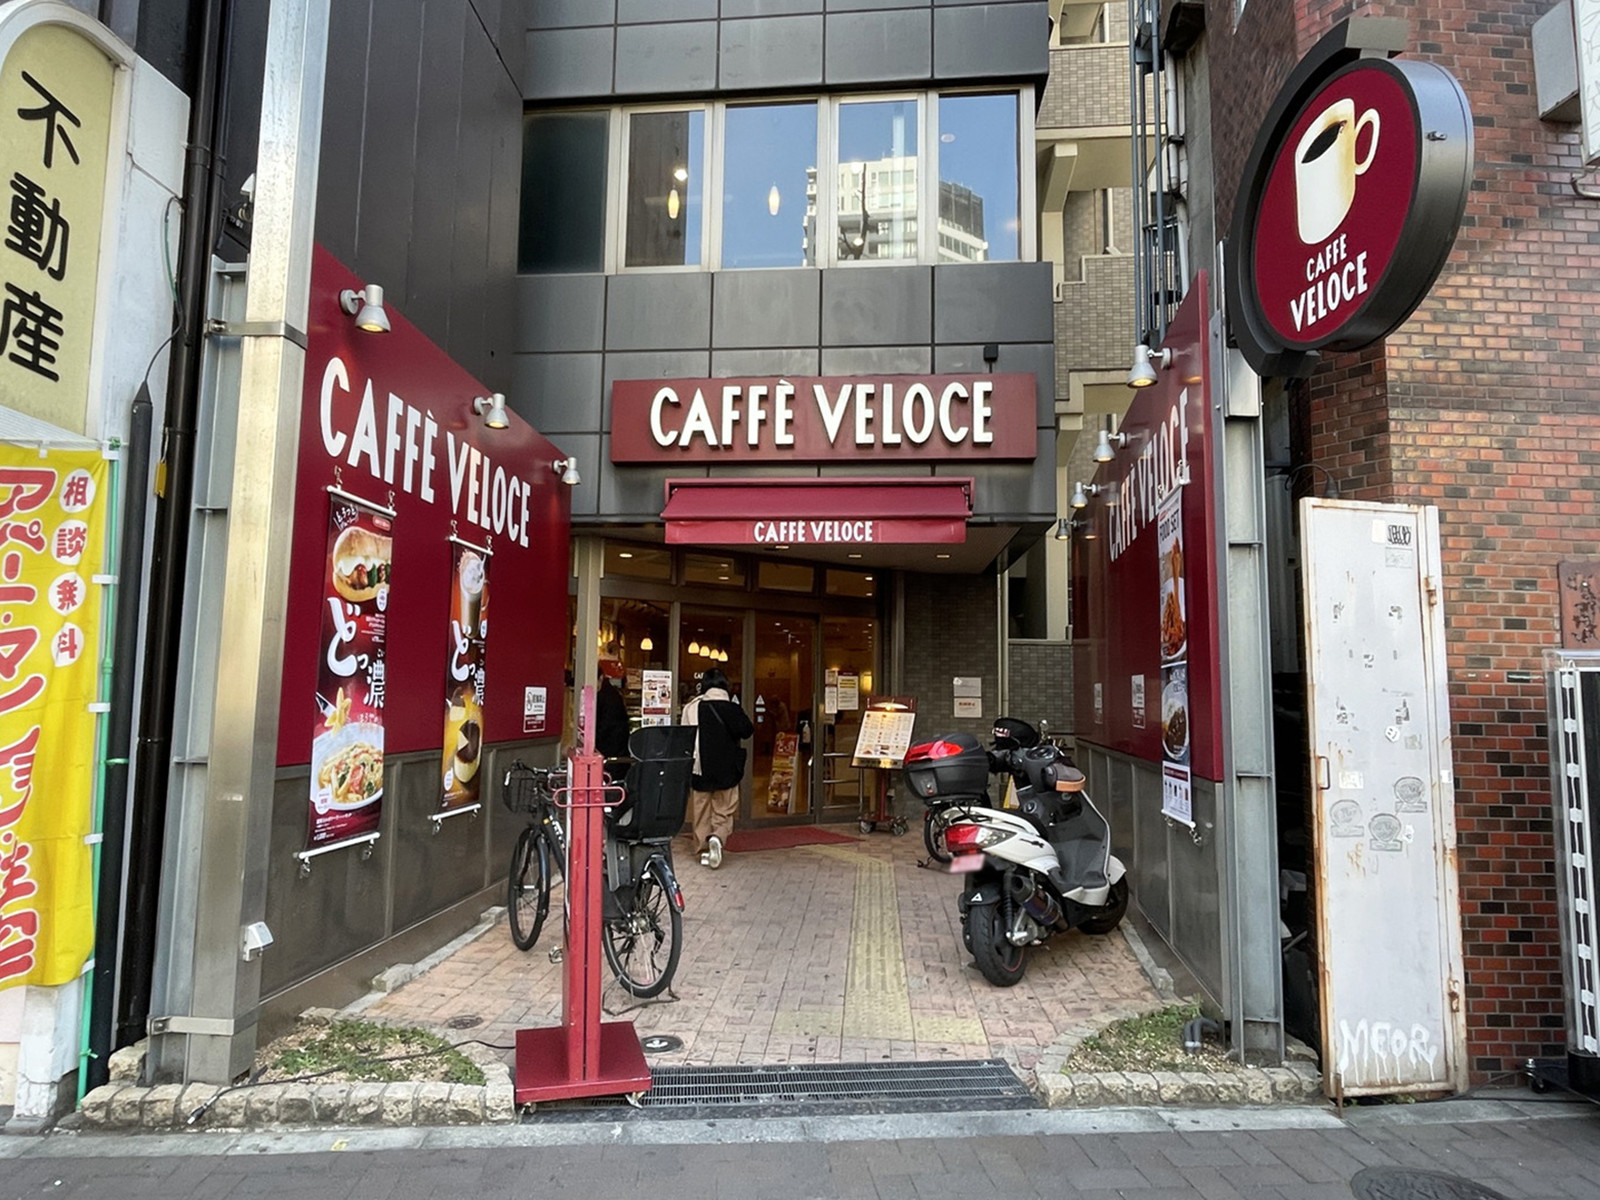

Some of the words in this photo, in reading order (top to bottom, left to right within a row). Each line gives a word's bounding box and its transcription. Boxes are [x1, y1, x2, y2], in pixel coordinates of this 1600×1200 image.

[0, 70, 81, 383] 不動産
[1289, 251, 1369, 333] VELOCE
[320, 357, 439, 504] CAFFÈ
[446, 430, 532, 548] VELOCE
[650, 379, 796, 449] CAFFÈ
[813, 380, 995, 449] VELOCE
[1137, 387, 1191, 530] VELOCE
[753, 519, 806, 543] CAFFÈ
[810, 520, 874, 543] VELOCE
